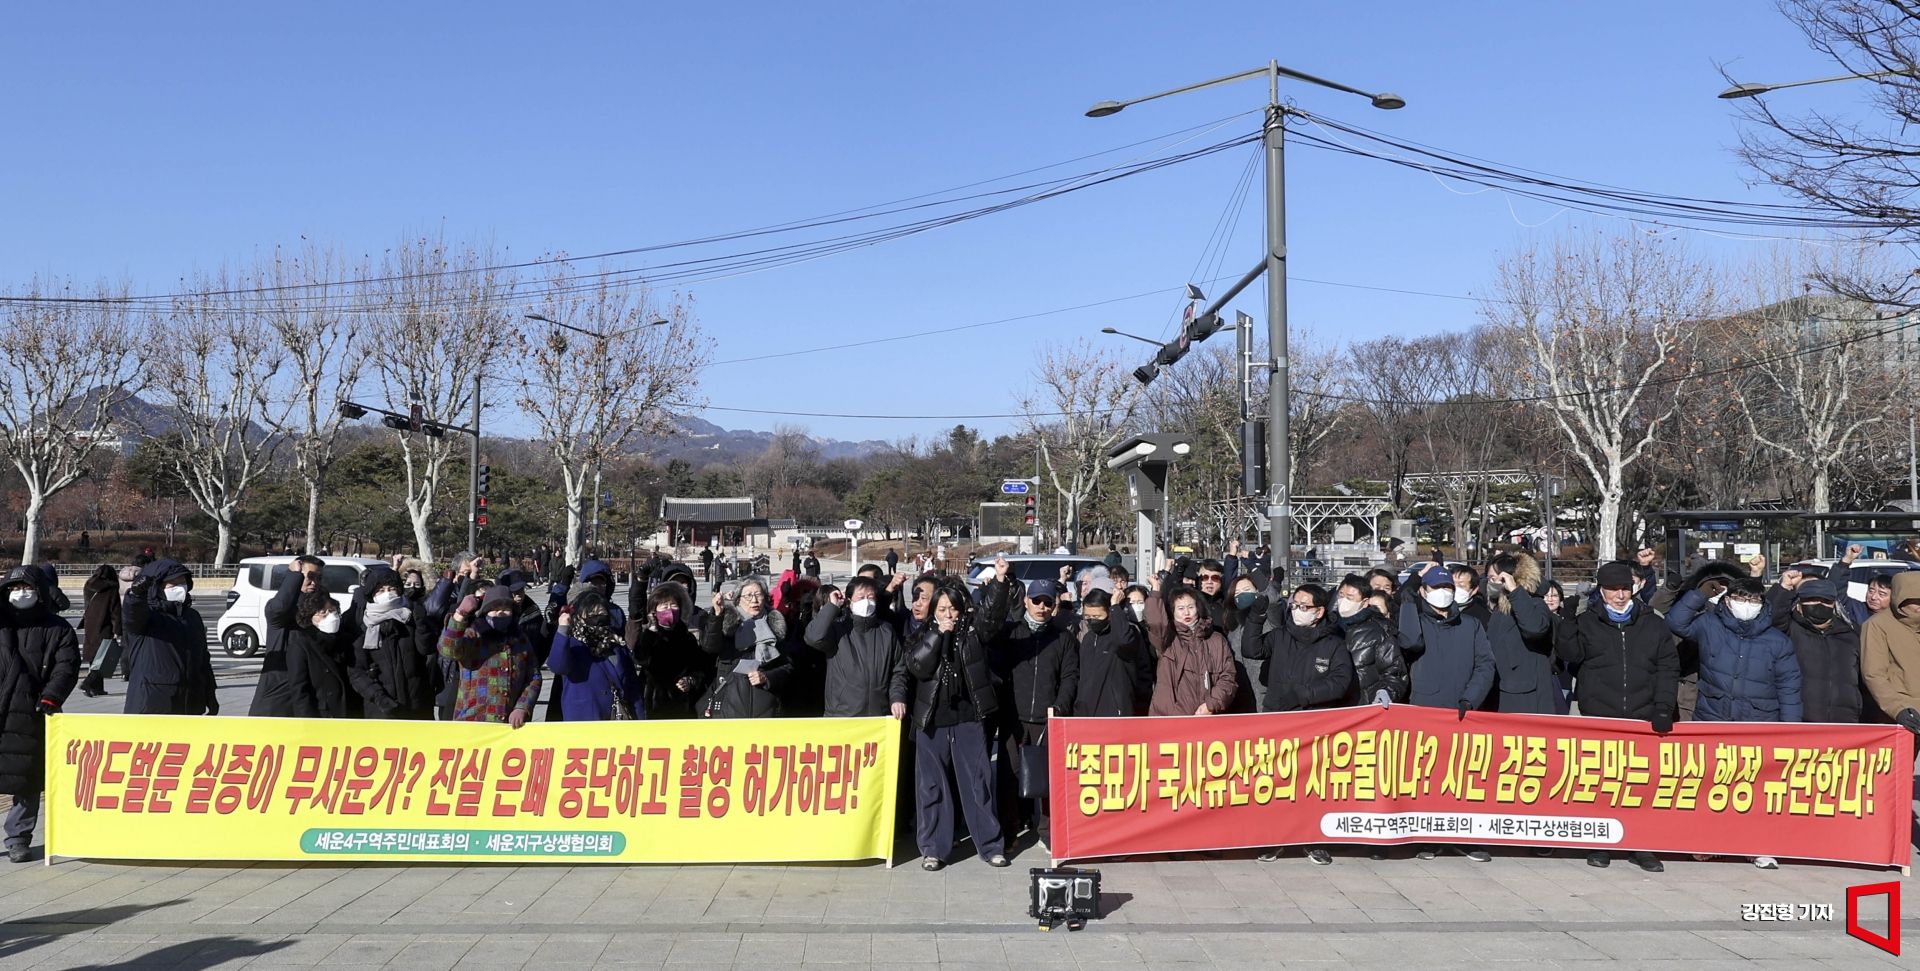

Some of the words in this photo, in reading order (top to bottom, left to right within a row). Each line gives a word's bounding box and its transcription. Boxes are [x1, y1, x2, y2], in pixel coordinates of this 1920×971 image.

[67, 740, 191, 814] “애드벌룬
[186, 743, 285, 815] 실증이
[285, 746, 425, 816] 무서운가?
[425, 747, 490, 817] 진실
[493, 747, 554, 818] 은폐
[558, 746, 672, 818] 중단하고
[679, 743, 733, 818] 촬영
[743, 742, 878, 816] 허가하라!”
[1066, 742, 1150, 817] “종묘가
[1157, 738, 1300, 812] 국사유산청의
[1306, 729, 1439, 802] 사유물이냐?
[1440, 731, 1494, 801] 시민
[1496, 735, 1548, 804] 검증
[1549, 738, 1651, 808] 가로막는
[1652, 742, 1706, 810] 밀실
[1707, 742, 1762, 813] 행정
[1763, 746, 1892, 818] 규탄한다!”
[315, 831, 470, 851] 세운4구역주민대표회의
[485, 833, 613, 852] 세운지구상생협의회
[1336, 816, 1473, 834] 세운4구역주민대표회의
[1488, 818, 1610, 839] 세운지구상생협의회
